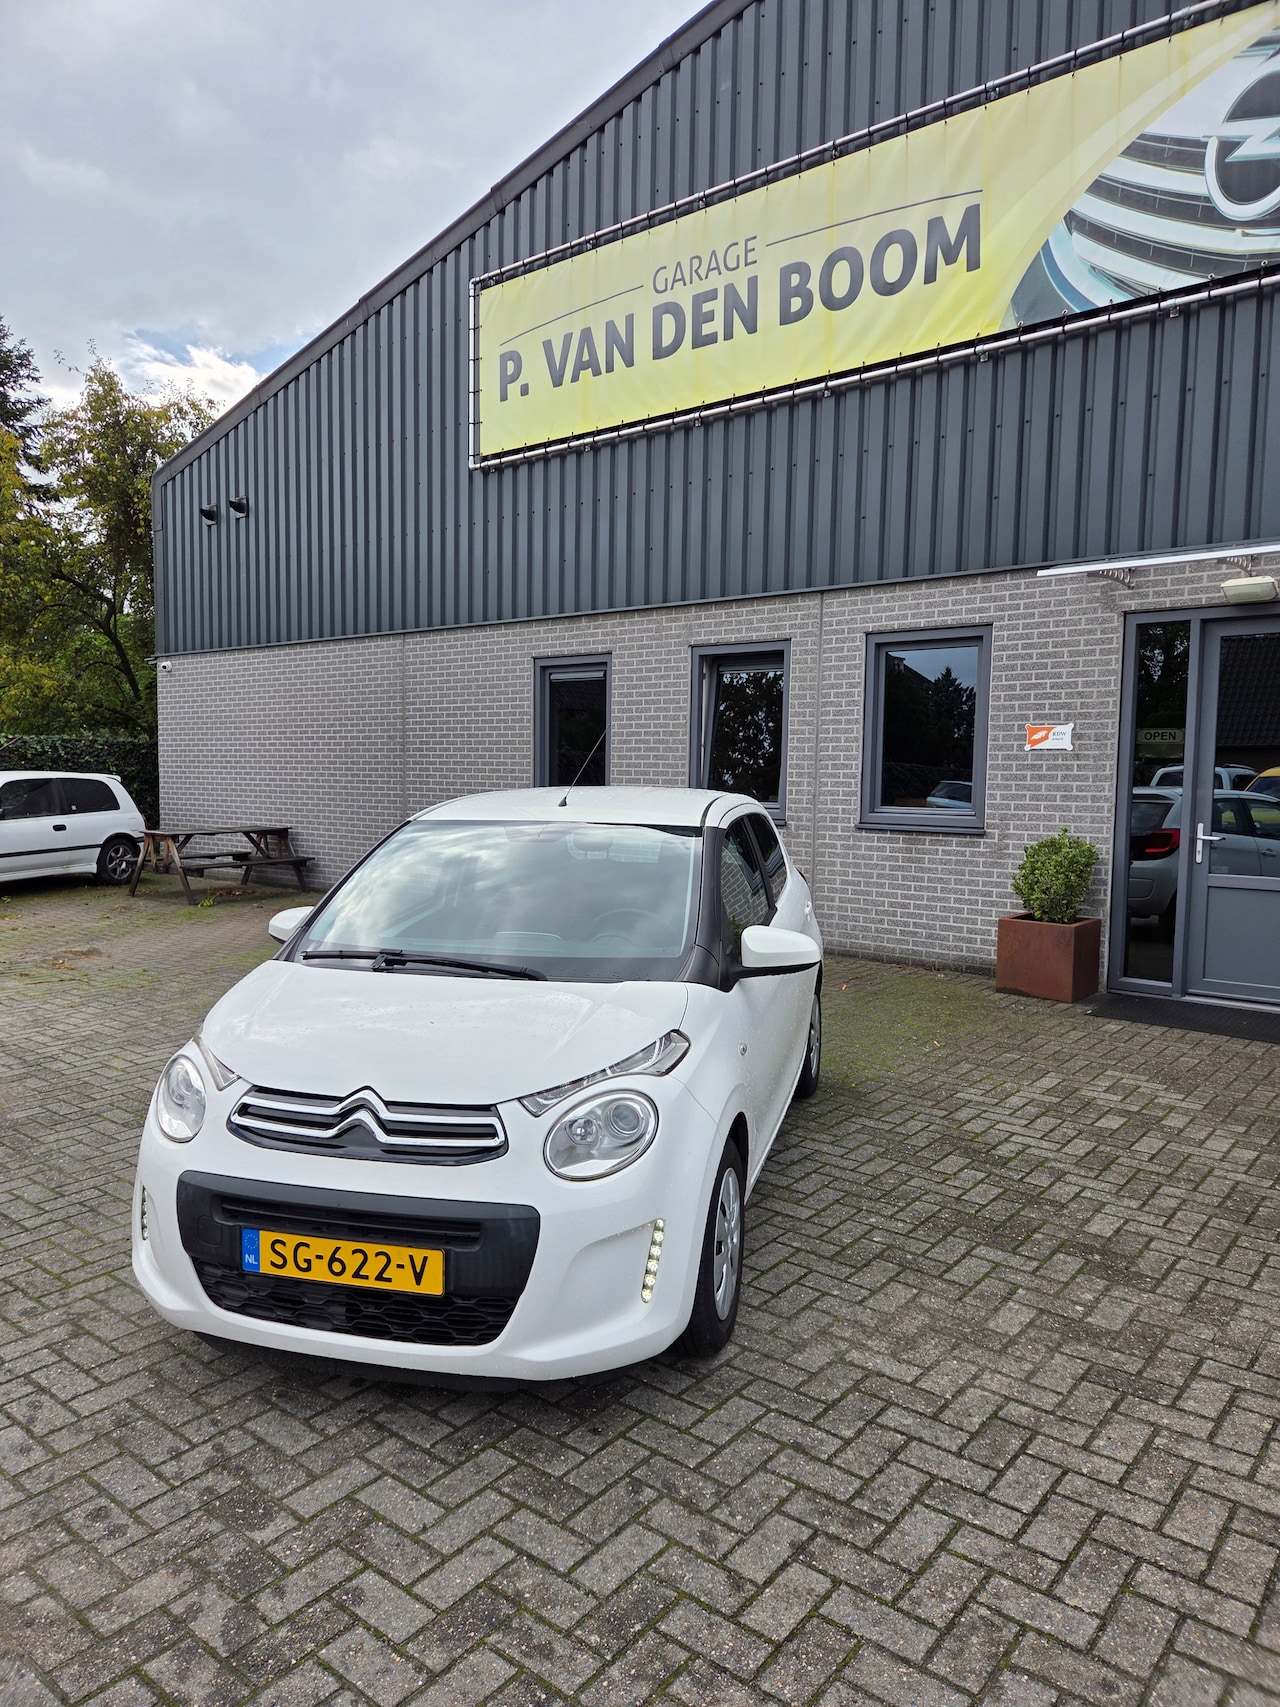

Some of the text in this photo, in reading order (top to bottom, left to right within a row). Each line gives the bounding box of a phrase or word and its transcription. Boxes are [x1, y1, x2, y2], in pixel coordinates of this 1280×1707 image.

[652, 235, 758, 295] GARAGE
[499, 203, 981, 402] P. VAN DEN BOOM
[1144, 731, 1177, 741] OPEN
[245, 1238, 429, 1286] NL SG-622-V
